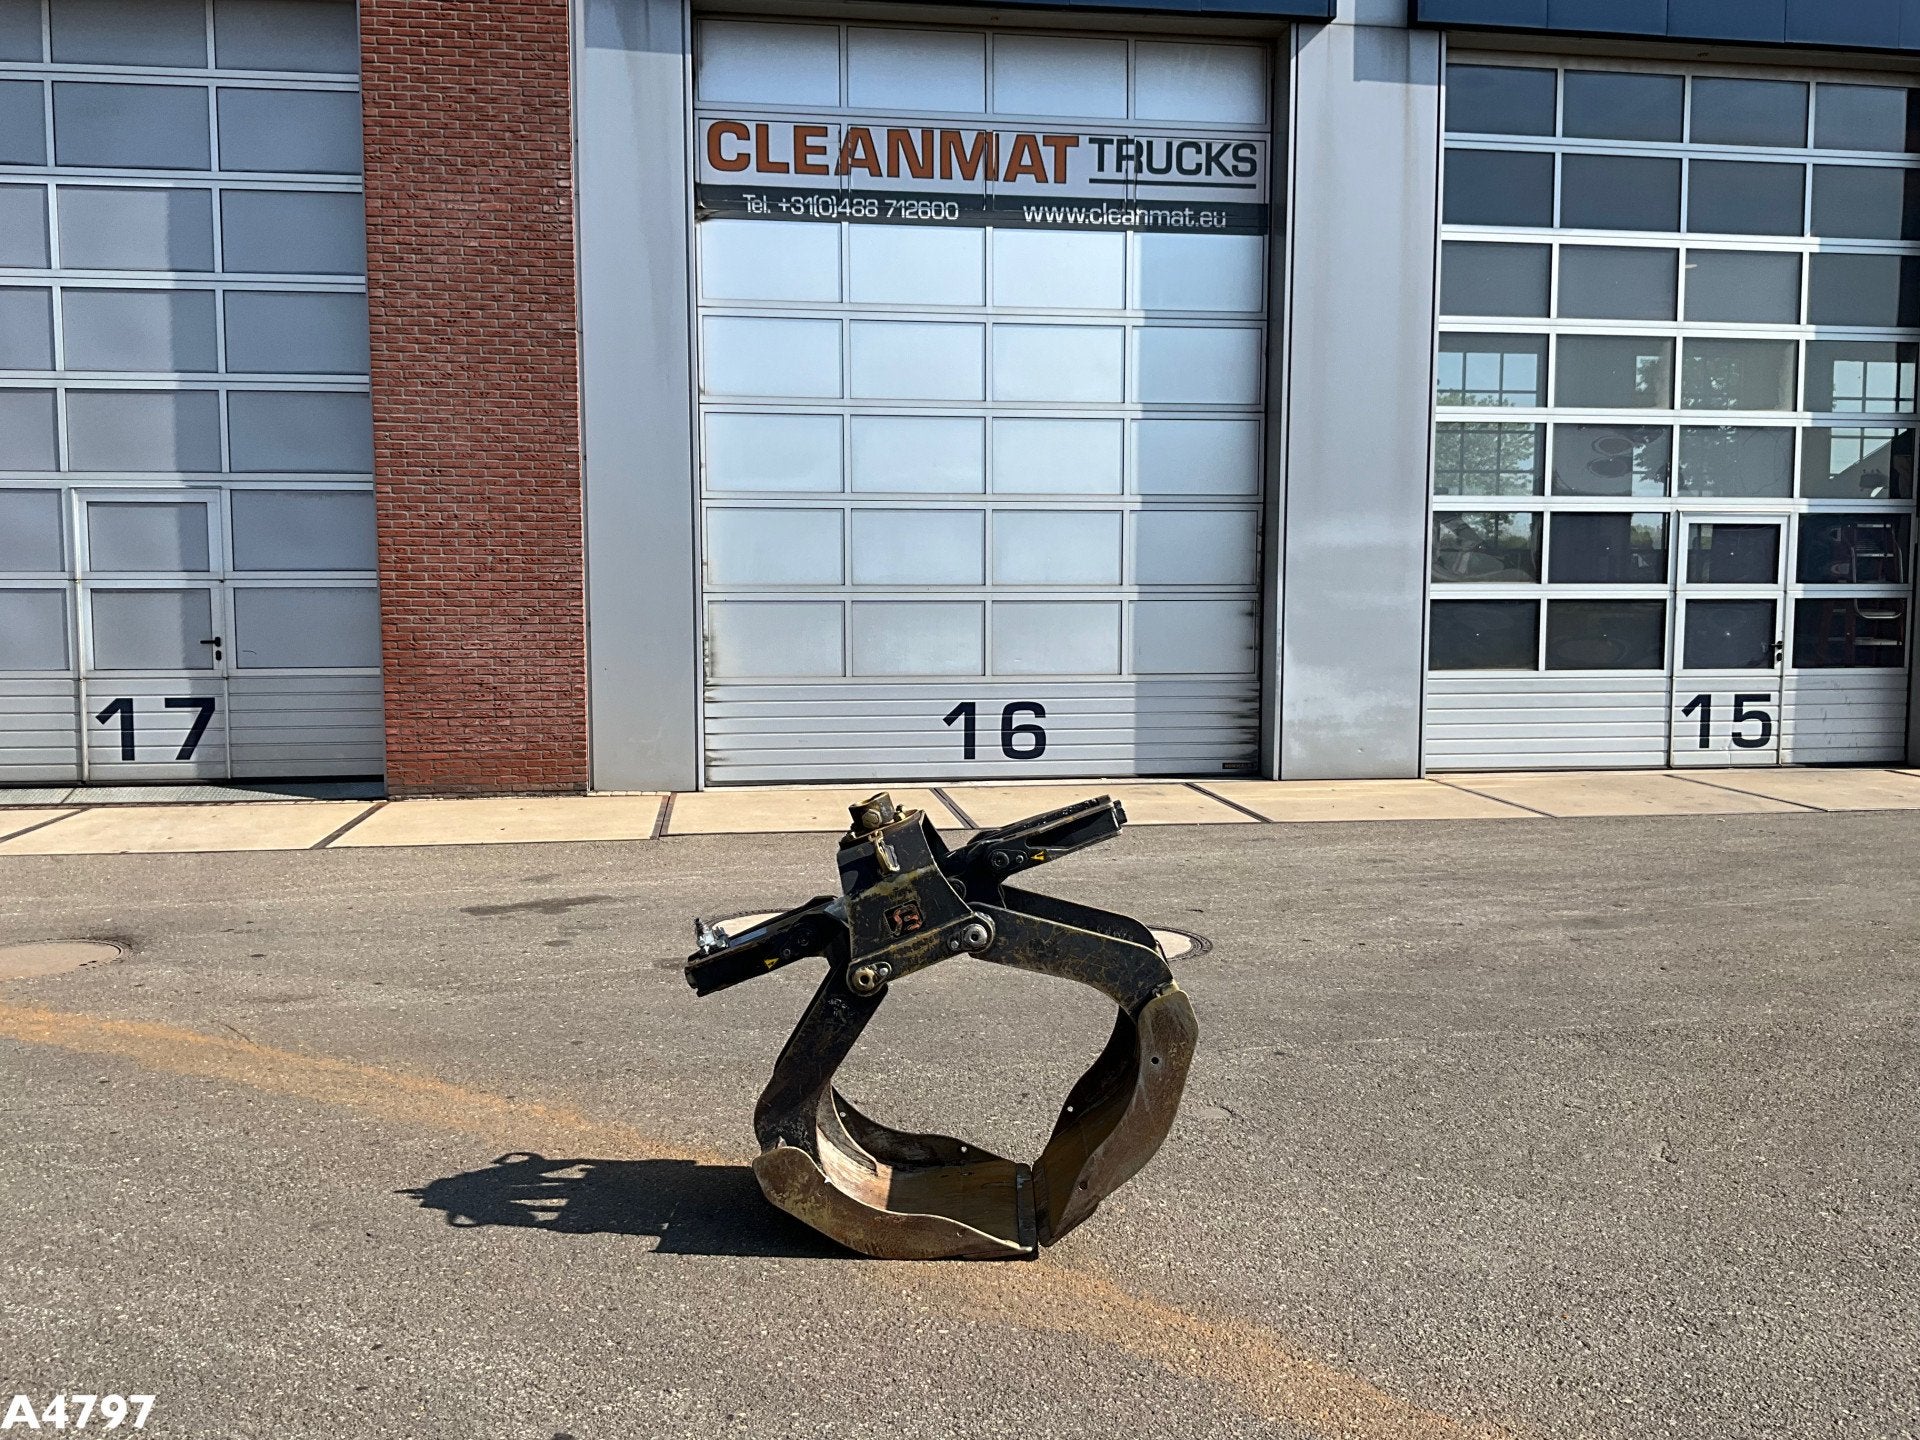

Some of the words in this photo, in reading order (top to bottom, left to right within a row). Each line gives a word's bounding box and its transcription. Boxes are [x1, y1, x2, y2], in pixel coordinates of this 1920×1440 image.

[707, 120, 1080, 184] CLEANMAT
[1088, 137, 1257, 178] TRUCKS
[743, 194, 771, 214] Tel.
[886, 199, 959, 220] 712600
[1023, 202, 1226, 228] www.cleanmat.eu
[95, 697, 216, 761] 17
[942, 701, 1047, 760] 16
[1681, 693, 1772, 749] 15
